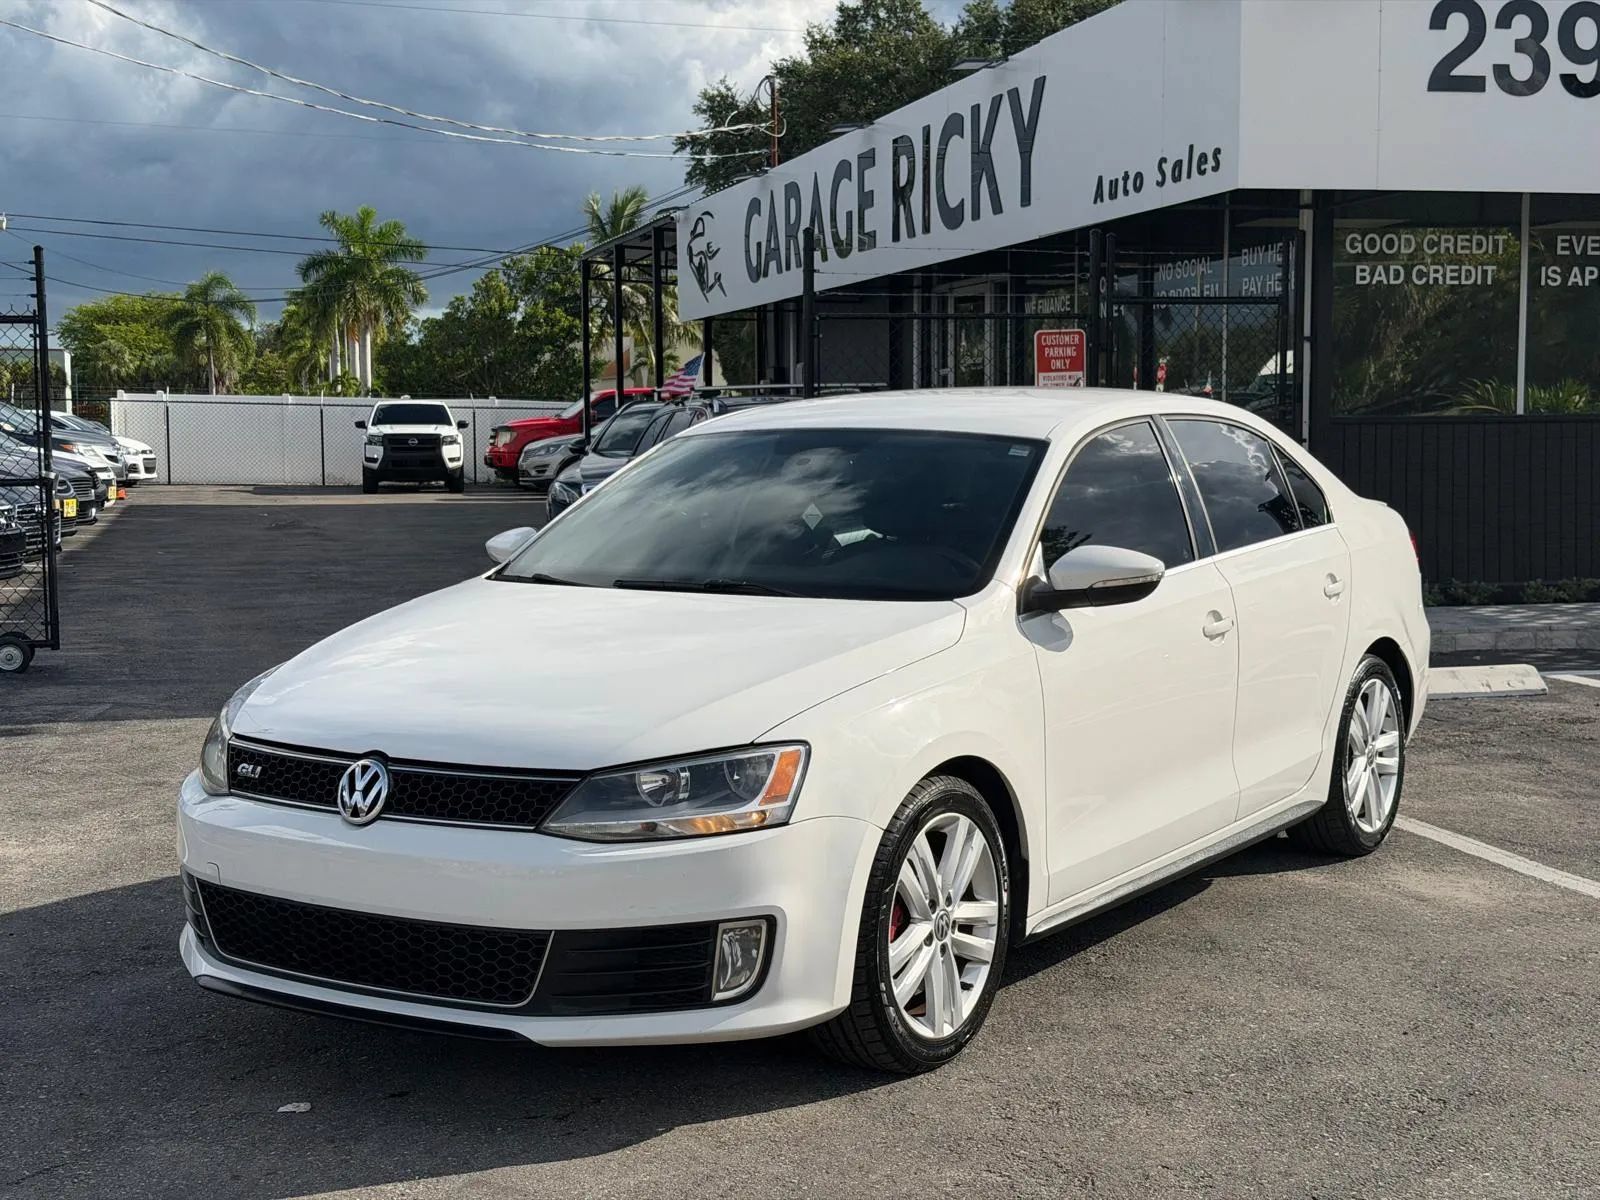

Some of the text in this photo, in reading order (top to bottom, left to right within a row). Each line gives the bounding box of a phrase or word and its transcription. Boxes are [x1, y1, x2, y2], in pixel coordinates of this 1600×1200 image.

[1427, 0, 1600, 98] 239
[745, 75, 1046, 283] GARAGE RICKY
[1094, 144, 1222, 204] Auto Sales
[1345, 233, 1509, 255] GOOD CREDIT
[1556, 235, 1600, 256] EVE
[1241, 245, 1265, 266] BUY
[1159, 256, 1213, 281] NO SOCIAL
[1355, 264, 1496, 286] BAD CREDIT
[1540, 266, 1599, 287] IS AP
[1242, 275, 1264, 297] PAY
[1037, 295, 1071, 314] FINANCE
[1041, 334, 1080, 346] CUSTOMER
[1044, 346, 1077, 357] PARKING
[1050, 359, 1071, 370] ONLY
[237, 763, 262, 779] GLI
